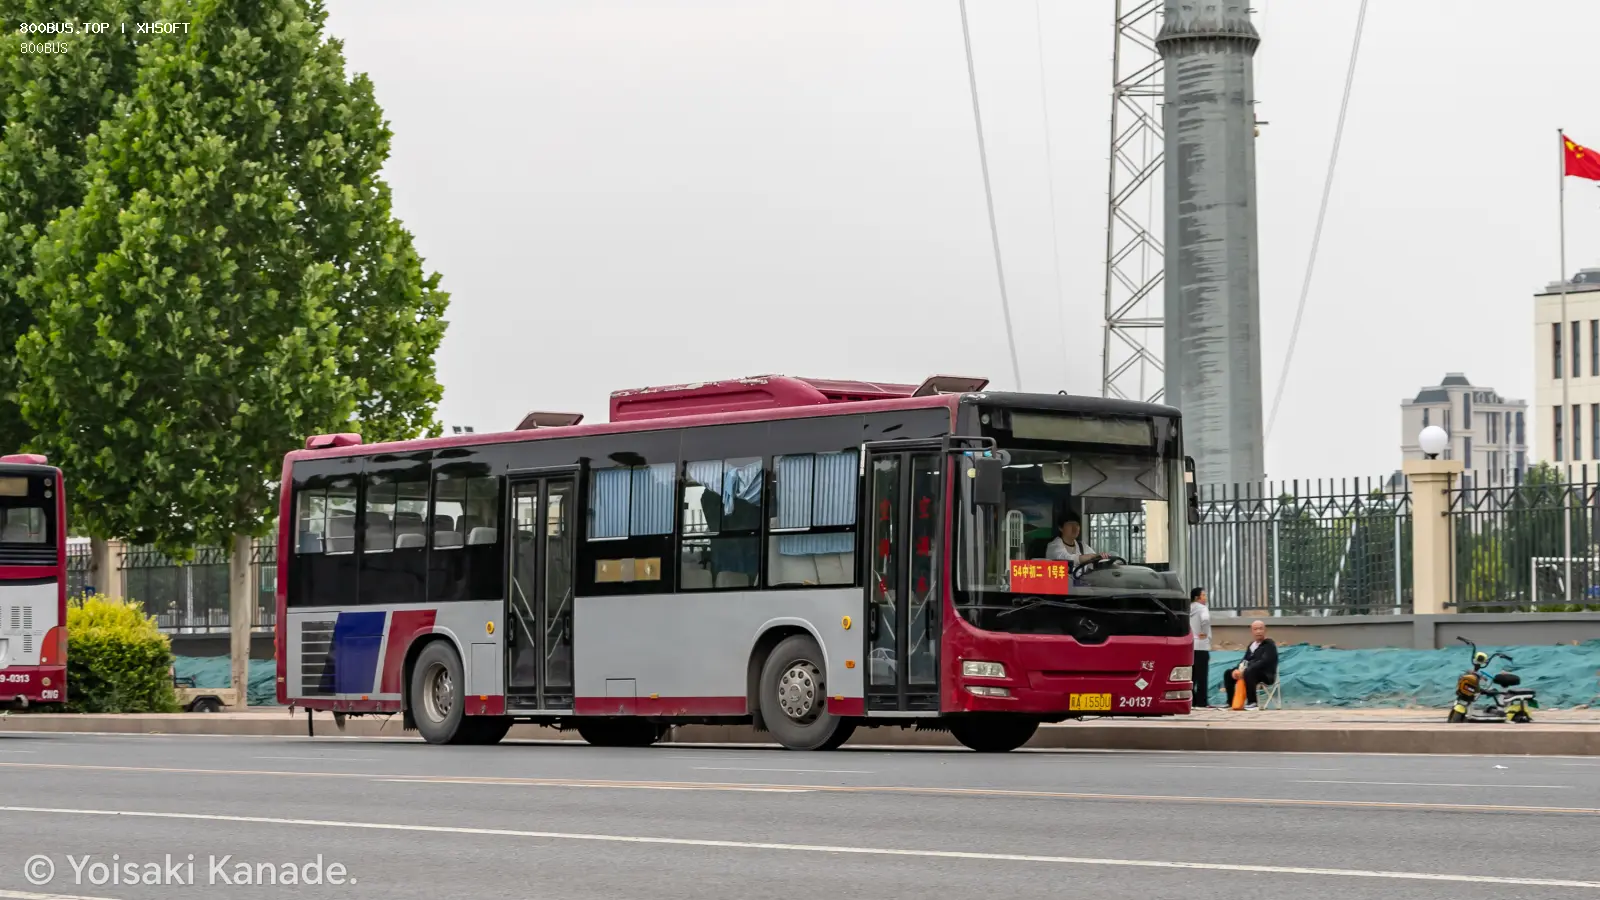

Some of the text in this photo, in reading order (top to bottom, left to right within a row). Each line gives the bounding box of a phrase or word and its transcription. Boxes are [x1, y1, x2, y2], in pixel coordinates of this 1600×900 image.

[1013, 564, 1066, 579] 54中初二 1号车
[1119, 696, 1153, 708] 2-0137
